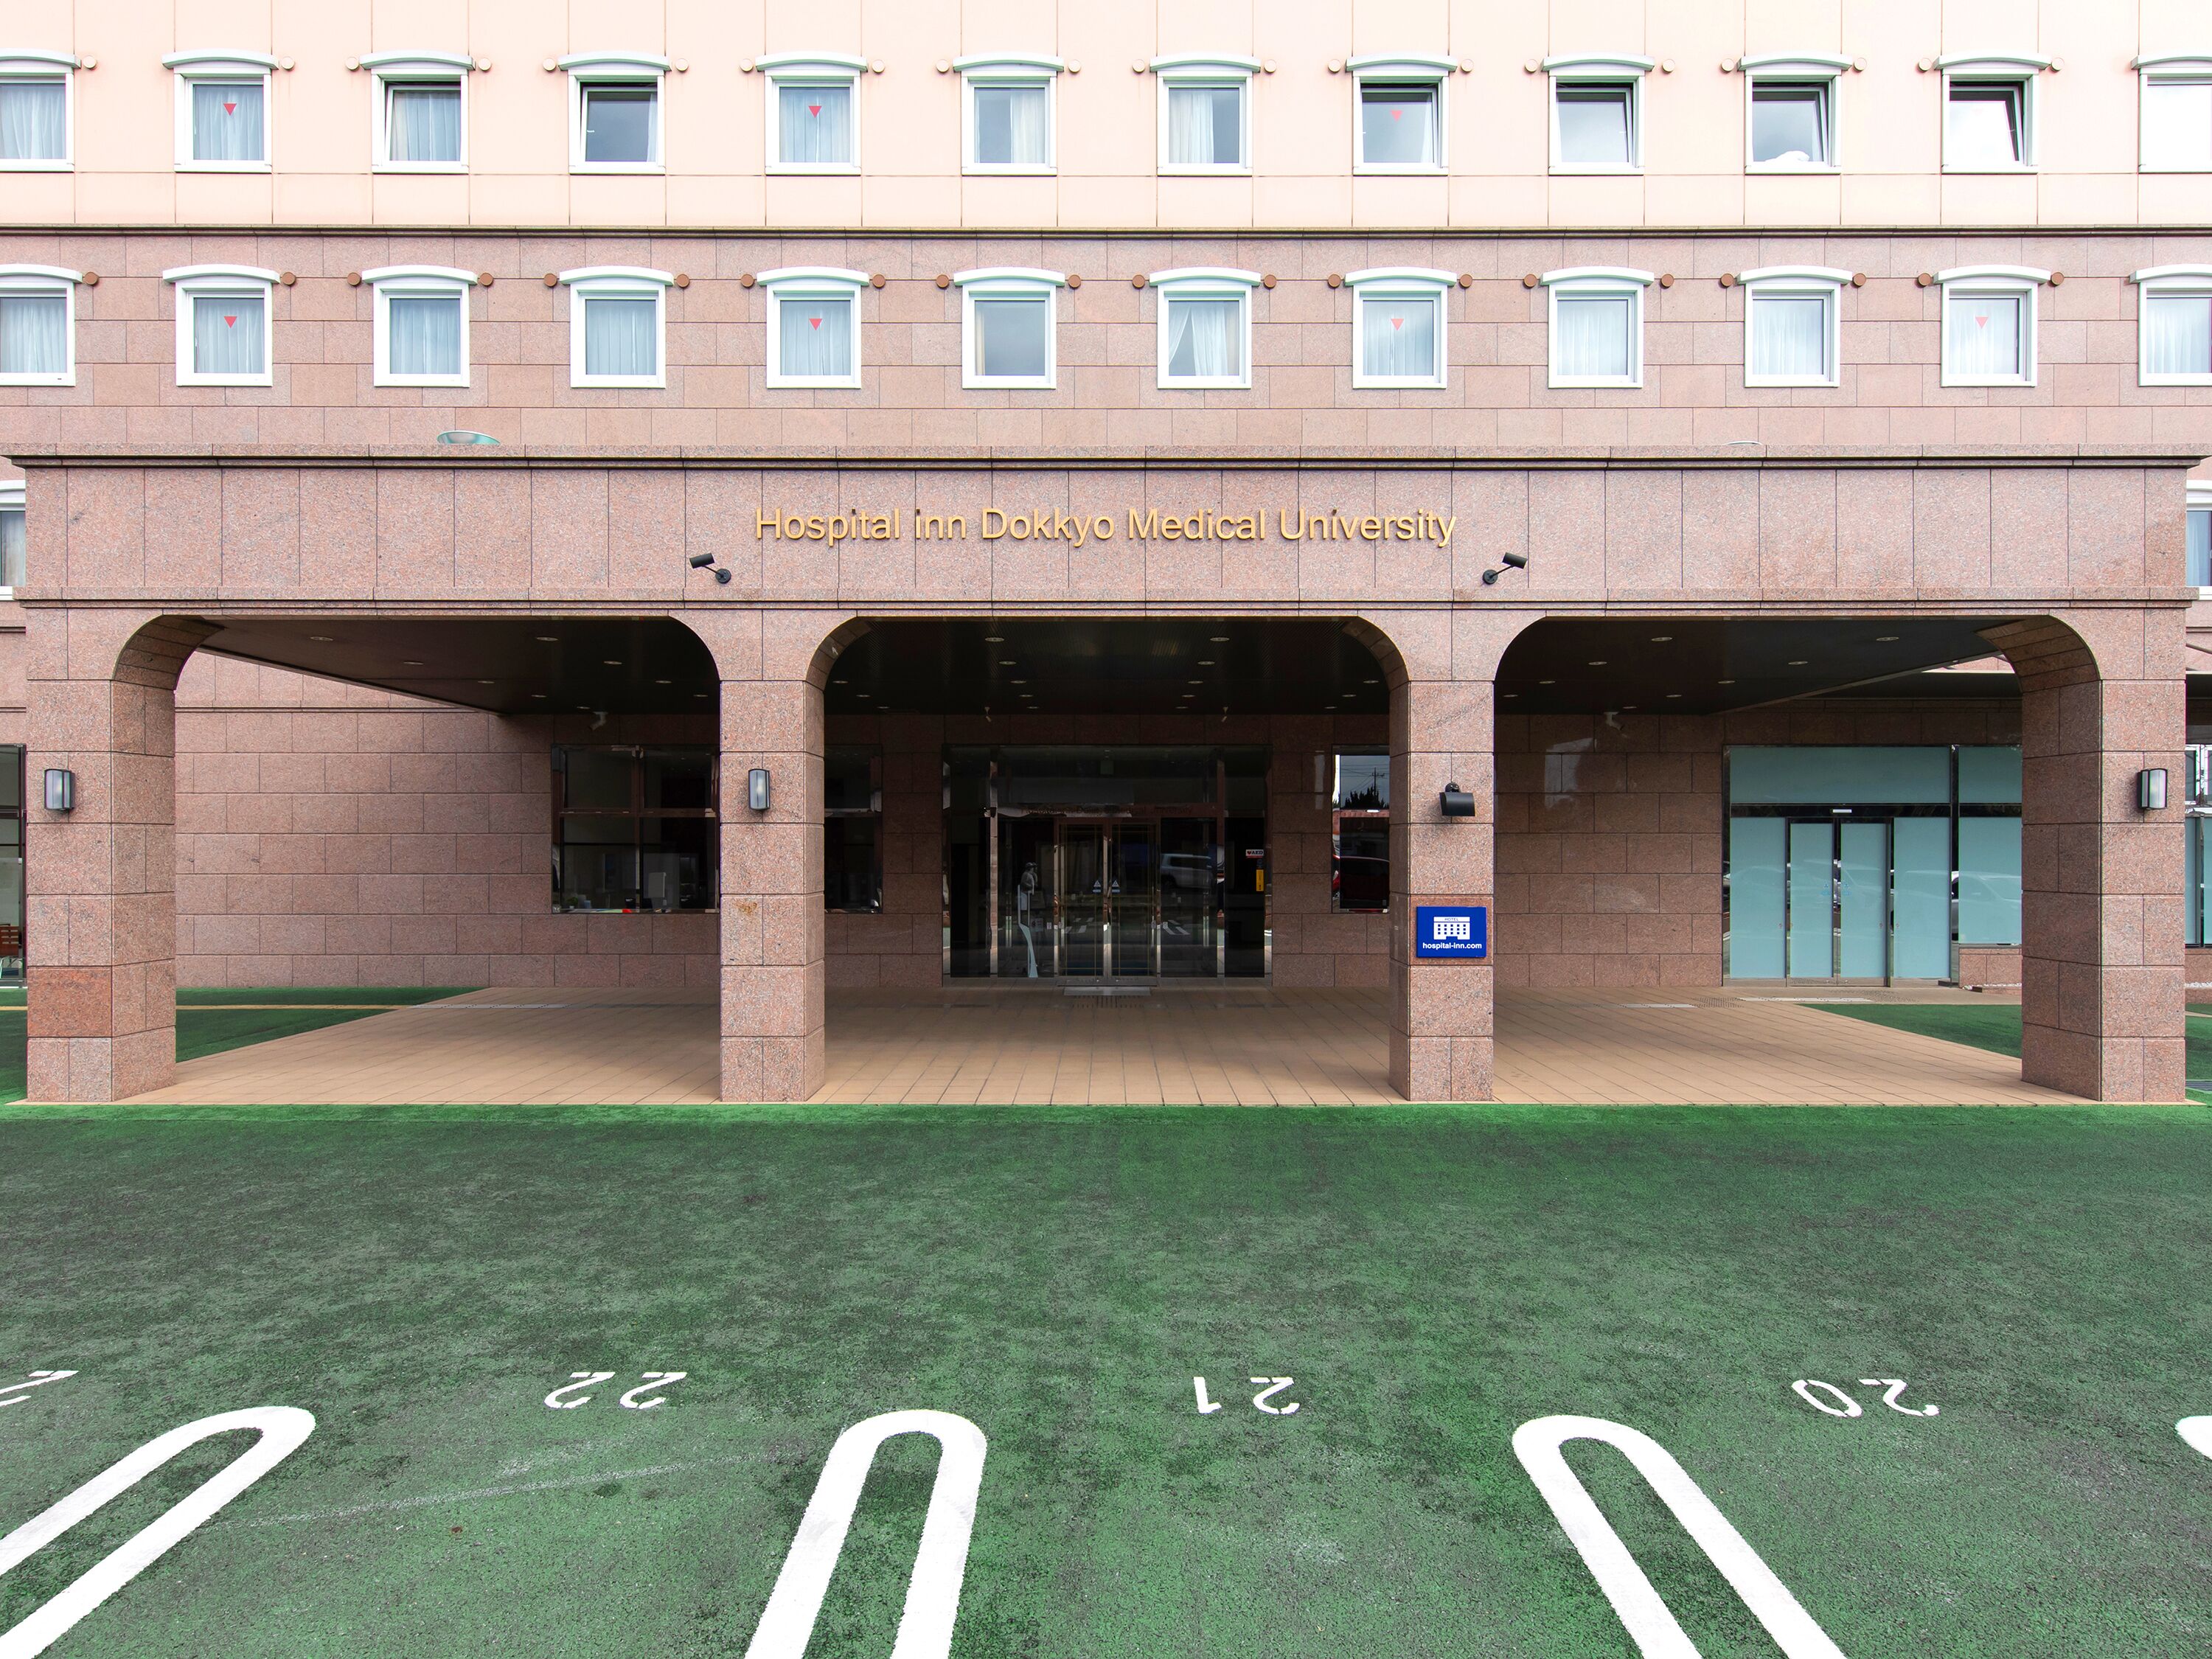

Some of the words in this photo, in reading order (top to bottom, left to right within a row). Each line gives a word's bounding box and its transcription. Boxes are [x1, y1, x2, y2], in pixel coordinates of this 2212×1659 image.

[755, 507, 901, 546] Hospital
[915, 507, 967, 539] inn
[981, 507, 1116, 548] Dokkyo
[1129, 508, 1267, 540] Medical
[1280, 508, 1457, 548] University
[543, 1371, 688, 1410] 22
[1192, 1376, 1301, 1416] 21
[1791, 1378, 1940, 1420] 20
